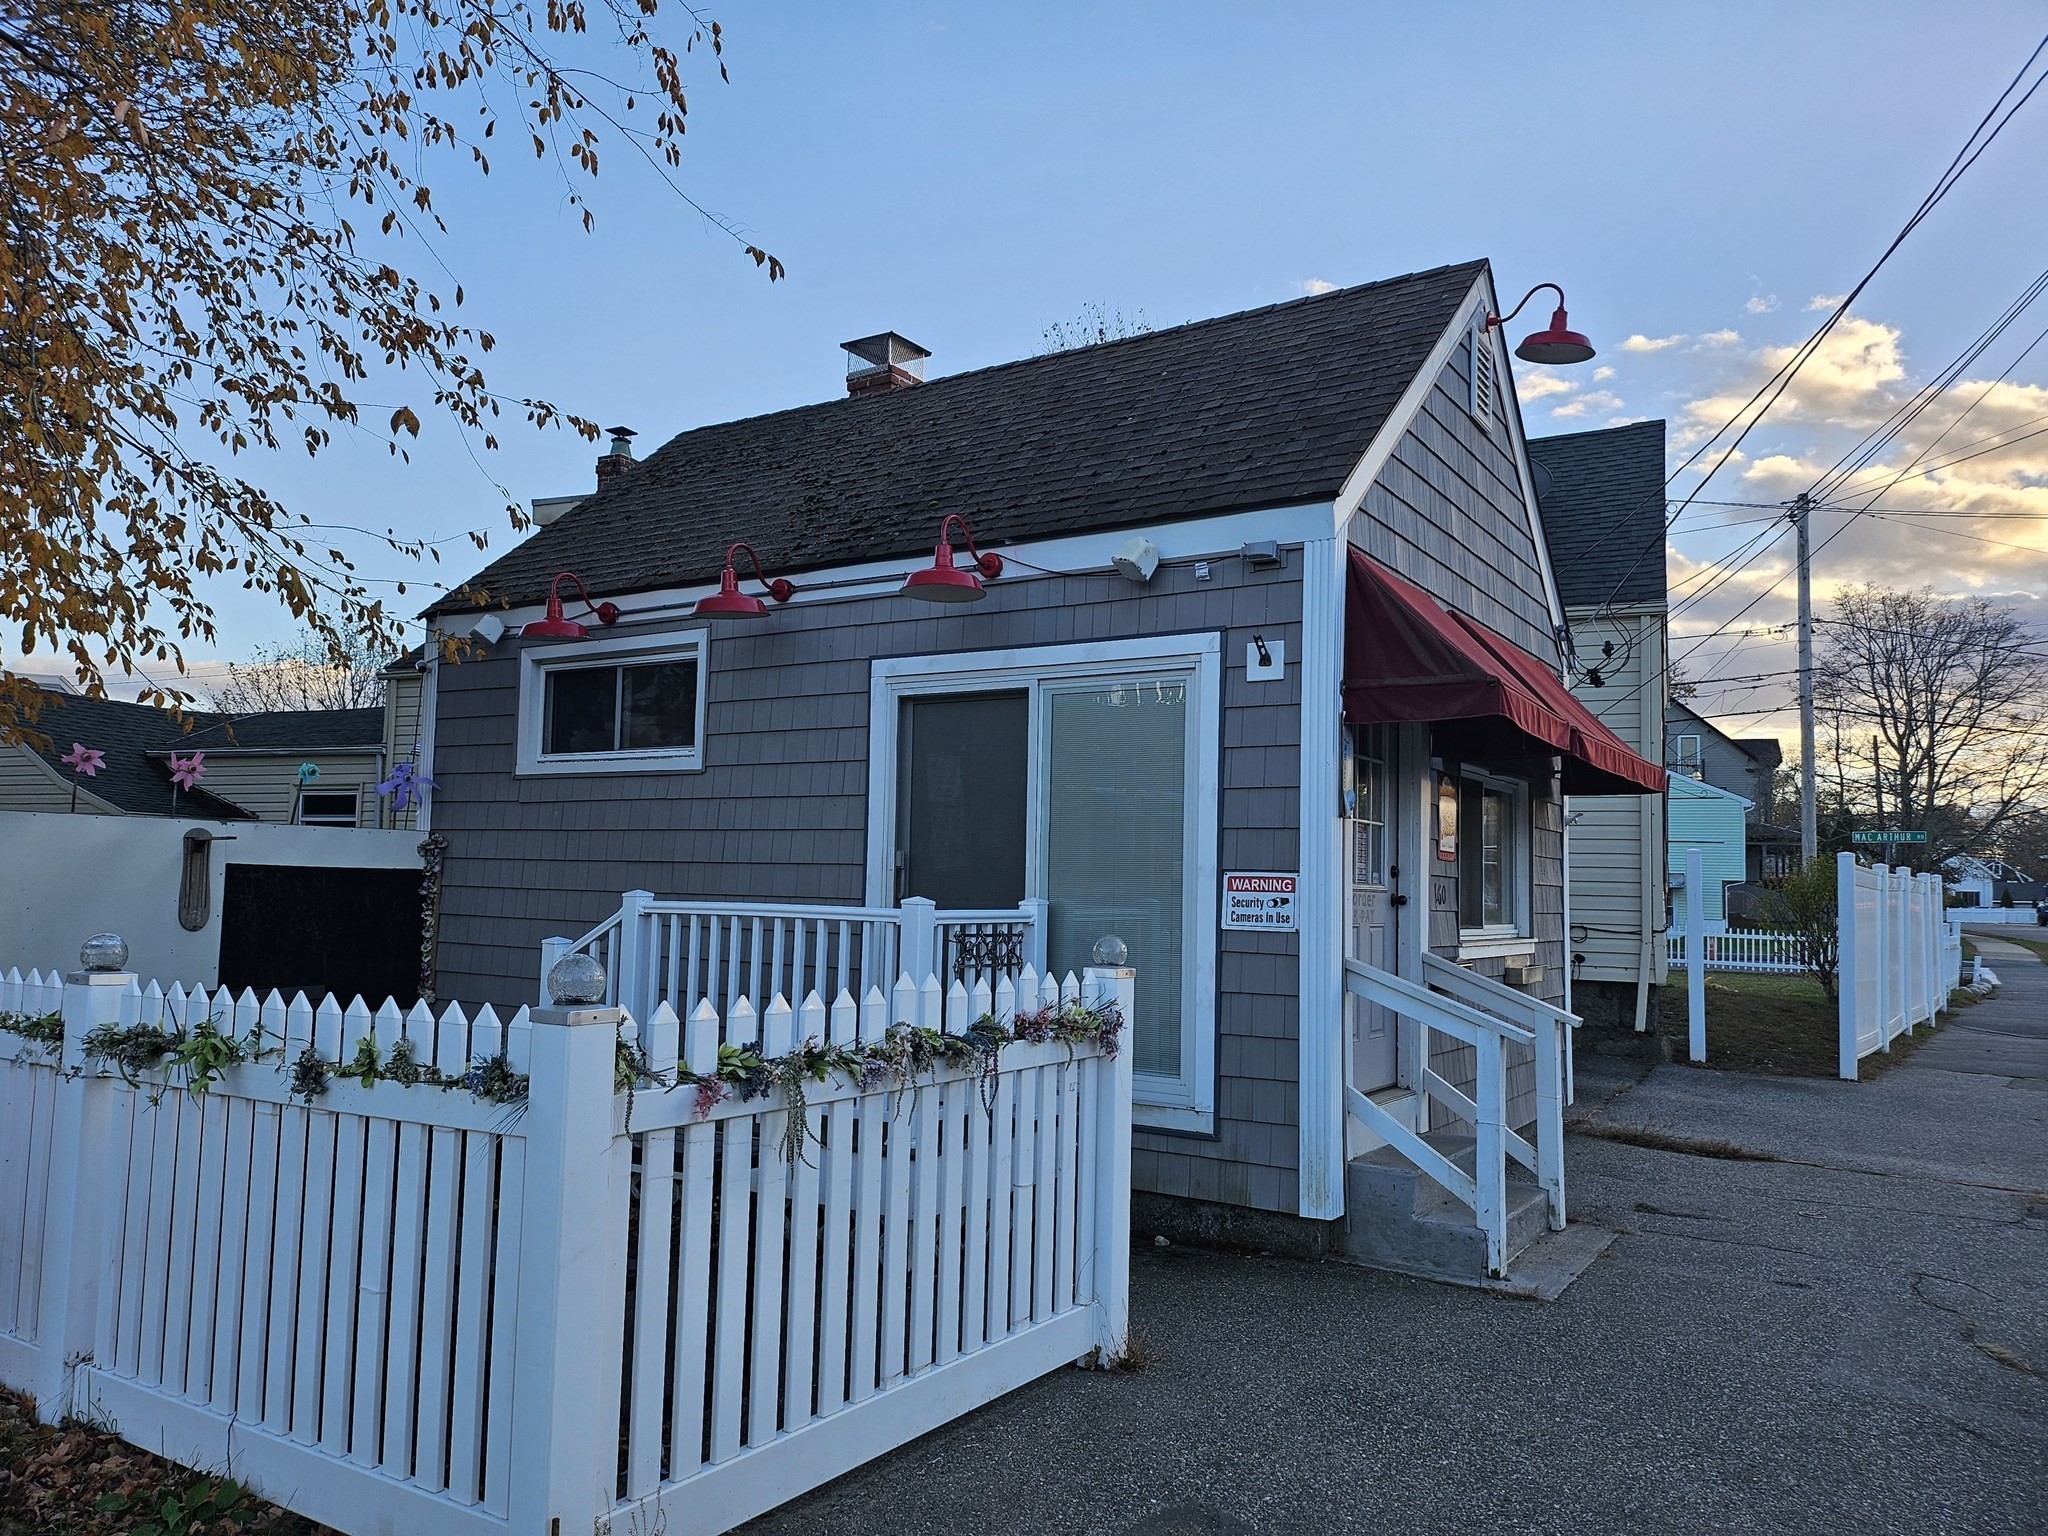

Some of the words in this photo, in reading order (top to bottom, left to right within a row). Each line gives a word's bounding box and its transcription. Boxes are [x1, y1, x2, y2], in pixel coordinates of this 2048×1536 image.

[1854, 833, 1872, 841] MAC
[1876, 832, 1911, 841] ARTHUR
[1231, 878, 1292, 891] WARNING
[1231, 896, 1264, 911] Security
[1231, 910, 1264, 923] Cameras
[1266, 911, 1274, 924] In
[1276, 911, 1291, 924] Use
